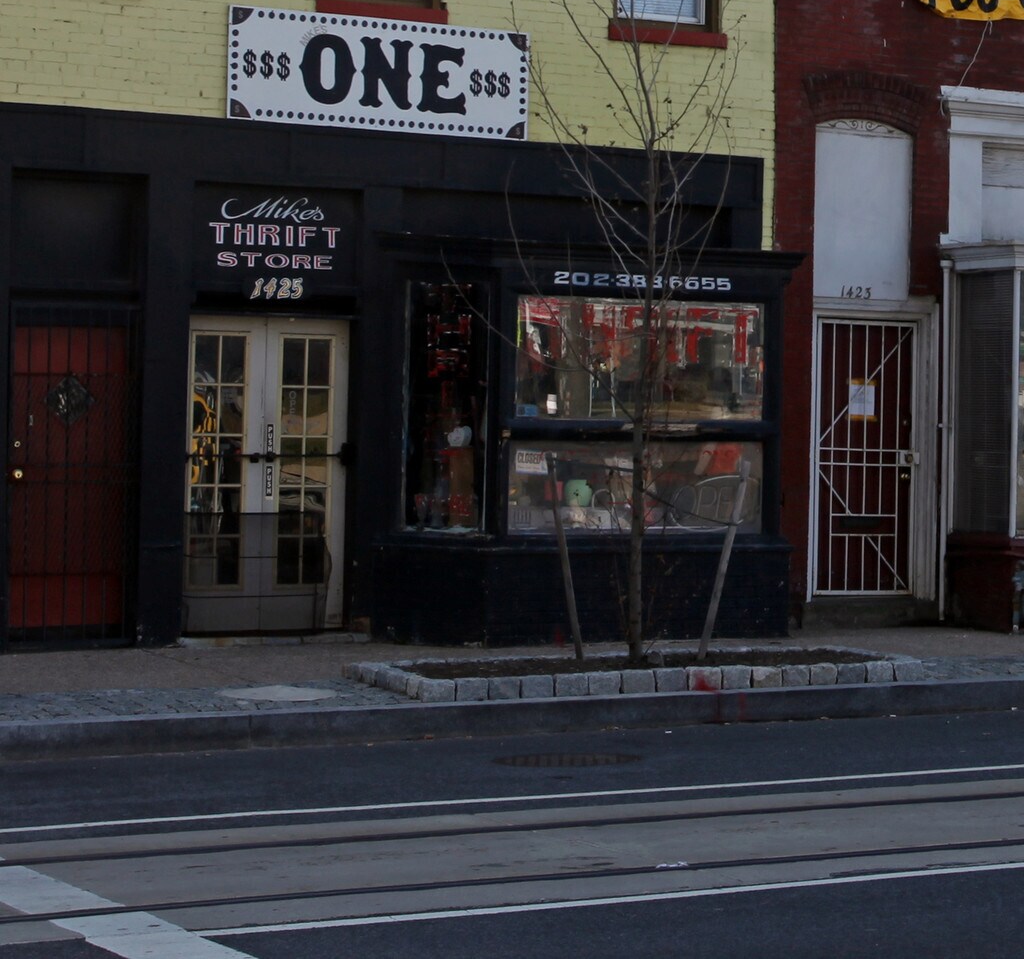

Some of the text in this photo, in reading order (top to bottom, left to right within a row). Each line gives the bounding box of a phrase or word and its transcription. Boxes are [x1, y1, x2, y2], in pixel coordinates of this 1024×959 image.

[243, 33, 511, 116] $$$ ONE $$$
[221, 195, 325, 223] Mike's
[209, 222, 341, 248] THRIFT
[217, 251, 333, 270] STORE
[249, 277, 304, 300] 1425
[840, 285, 873, 300] 1423
